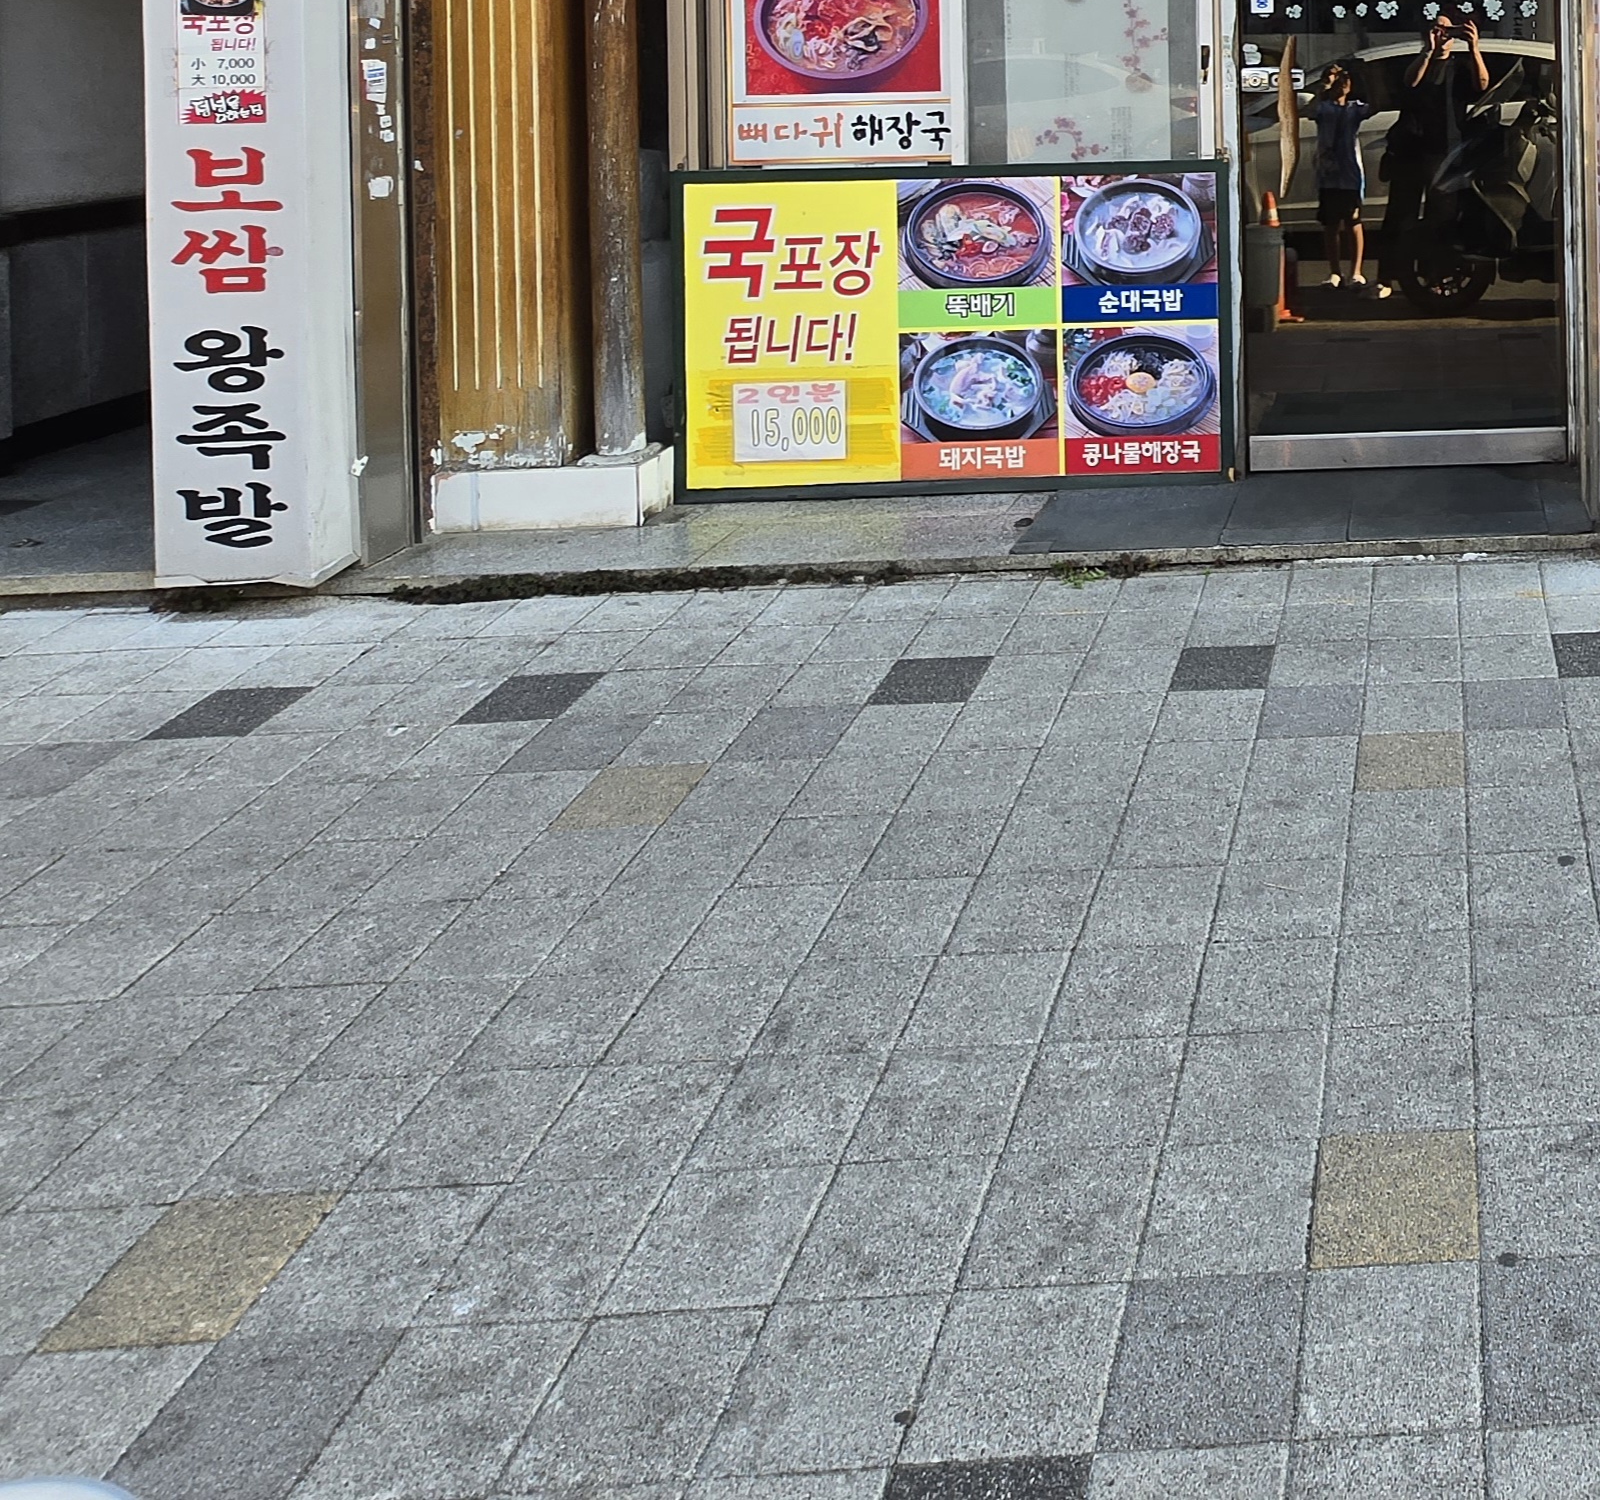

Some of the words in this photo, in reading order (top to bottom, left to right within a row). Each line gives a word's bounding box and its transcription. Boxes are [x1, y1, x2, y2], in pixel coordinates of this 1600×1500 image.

[211, 37, 256, 51] 됩니다!
[191, 74, 206, 86] 大
[851, 111, 952, 151] 해장국
[171, 147, 284, 294] 보쌈
[703, 206, 883, 298] 국포장
[945, 292, 1016, 318] 뚝배기
[1098, 288, 1184, 313] 순대국밥
[724, 312, 857, 364] 됩니다!
[173, 325, 289, 549] 왕족발
[752, 406, 842, 451] 15,000
[939, 443, 1027, 470] 돼지국밥
[1081, 439, 1201, 464] 콩나물해장국
